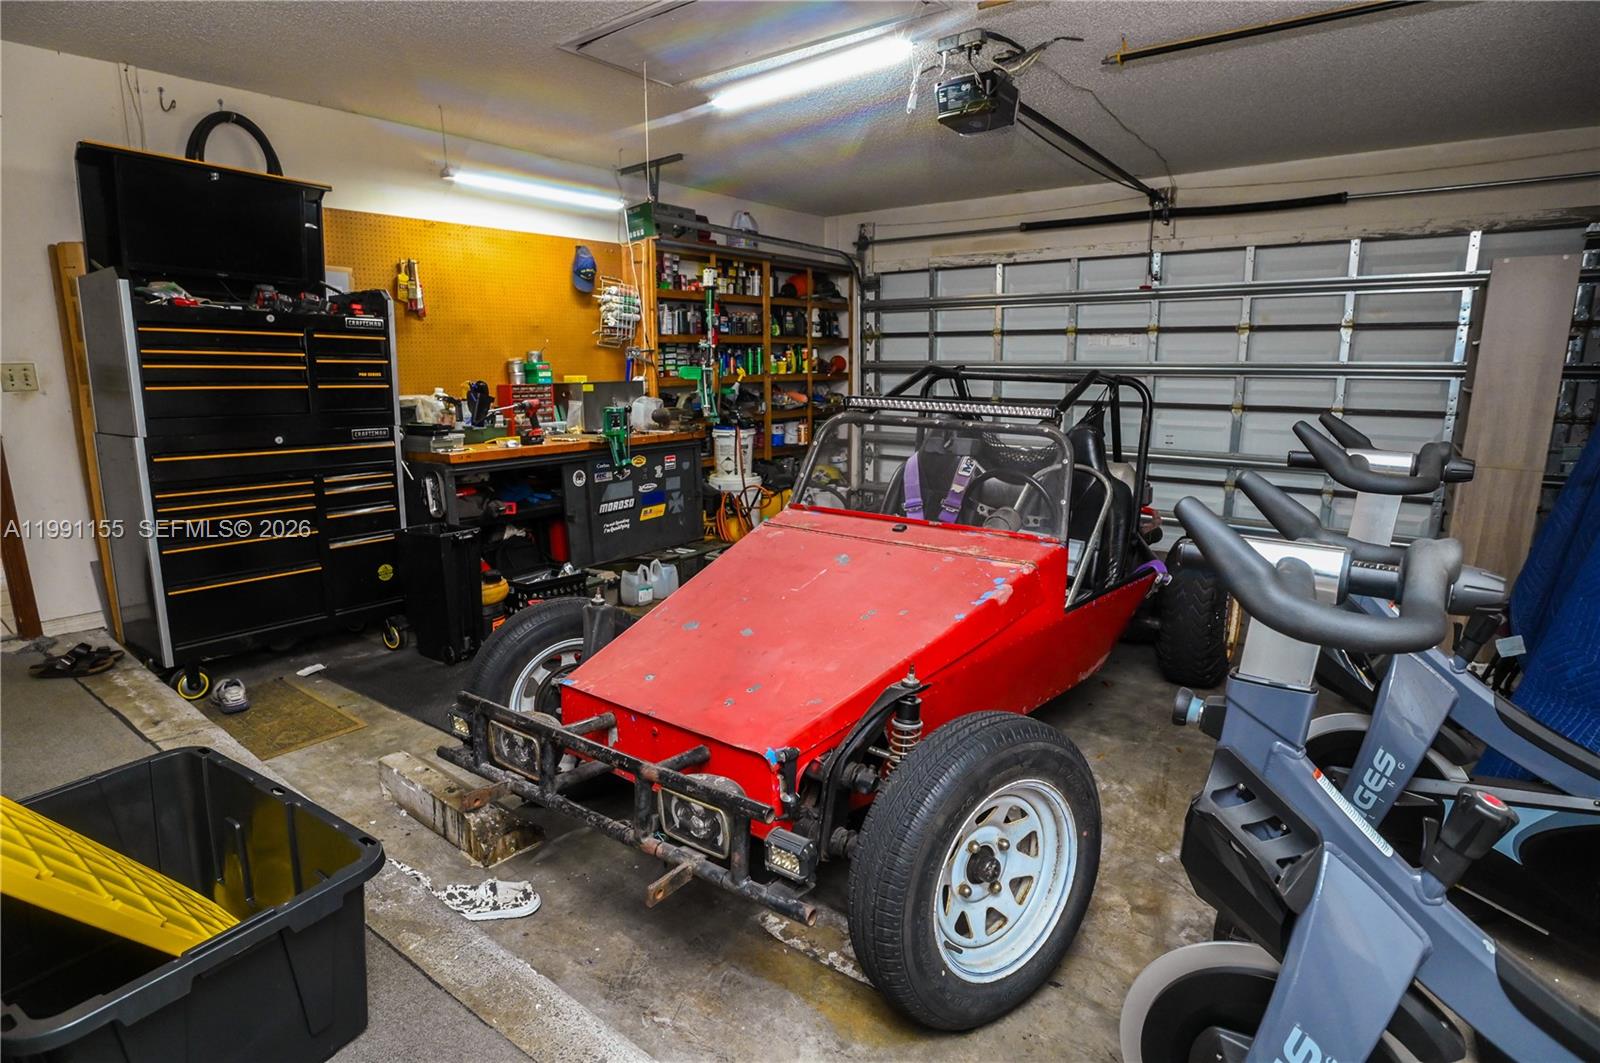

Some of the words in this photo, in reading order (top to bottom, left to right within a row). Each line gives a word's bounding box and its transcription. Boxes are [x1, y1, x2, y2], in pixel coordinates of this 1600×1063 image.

[354, 430, 387, 438] CRAFTSMAN
[599, 498, 635, 513] MOROSO
[1353, 748, 1396, 816] GES
